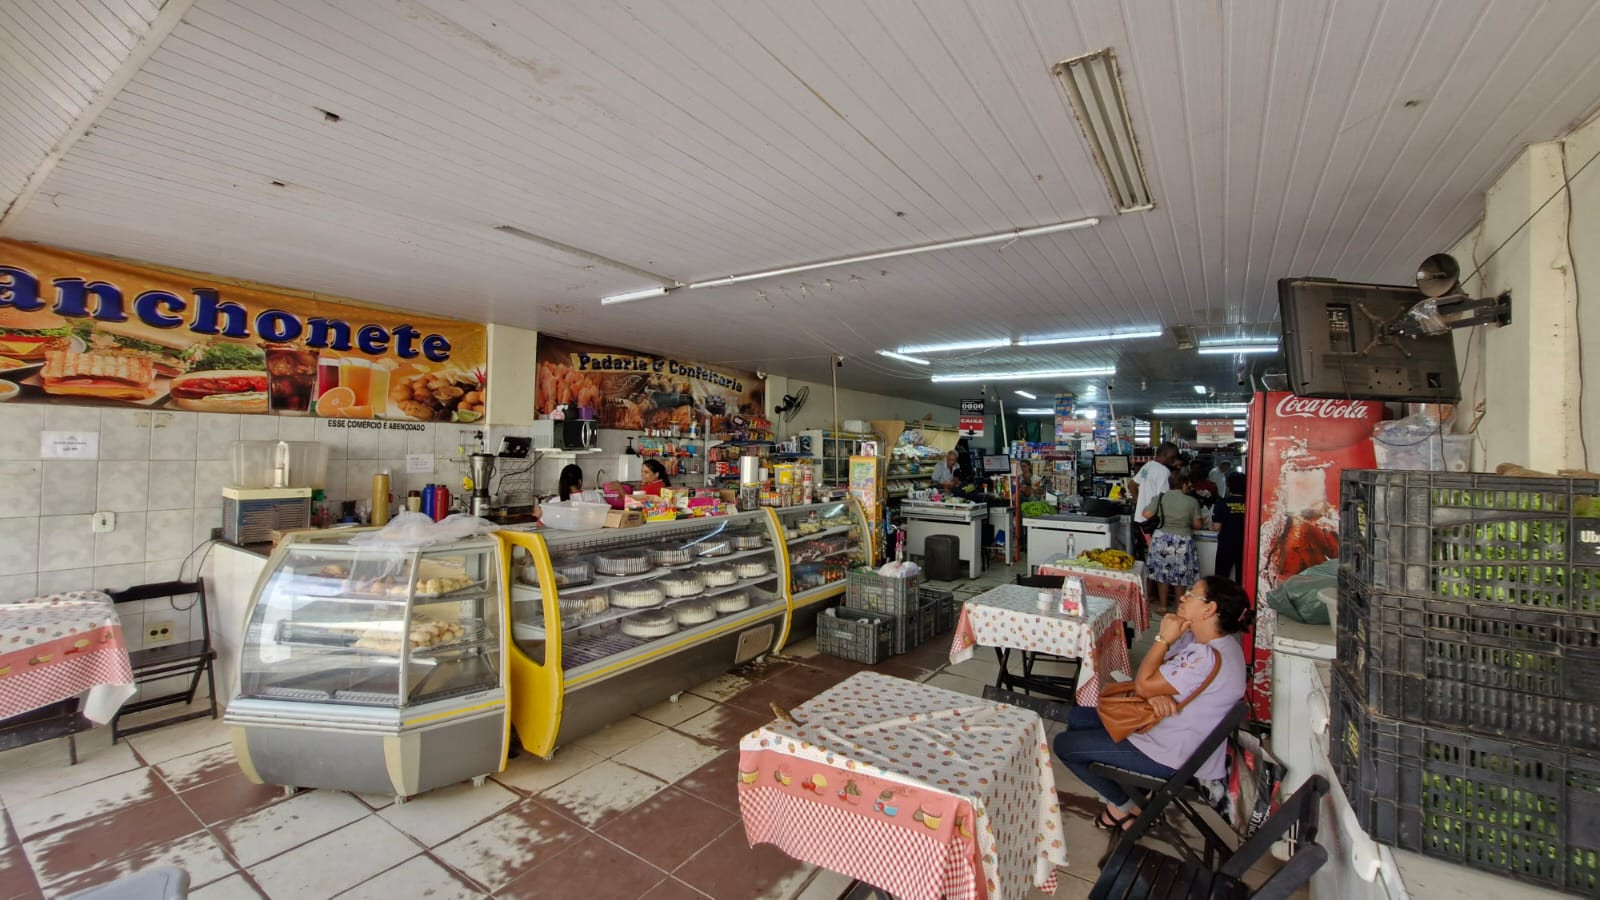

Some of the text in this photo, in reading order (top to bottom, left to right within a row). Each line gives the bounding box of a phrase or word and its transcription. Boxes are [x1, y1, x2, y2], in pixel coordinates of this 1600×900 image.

[578, 353, 648, 370] Padaria
[668, 360, 743, 393] Confeitaria
[1276, 394, 1368, 419] Coca-Cola
[328, 419, 346, 428] ESSE
[347, 420, 382, 429] COMERCIO
